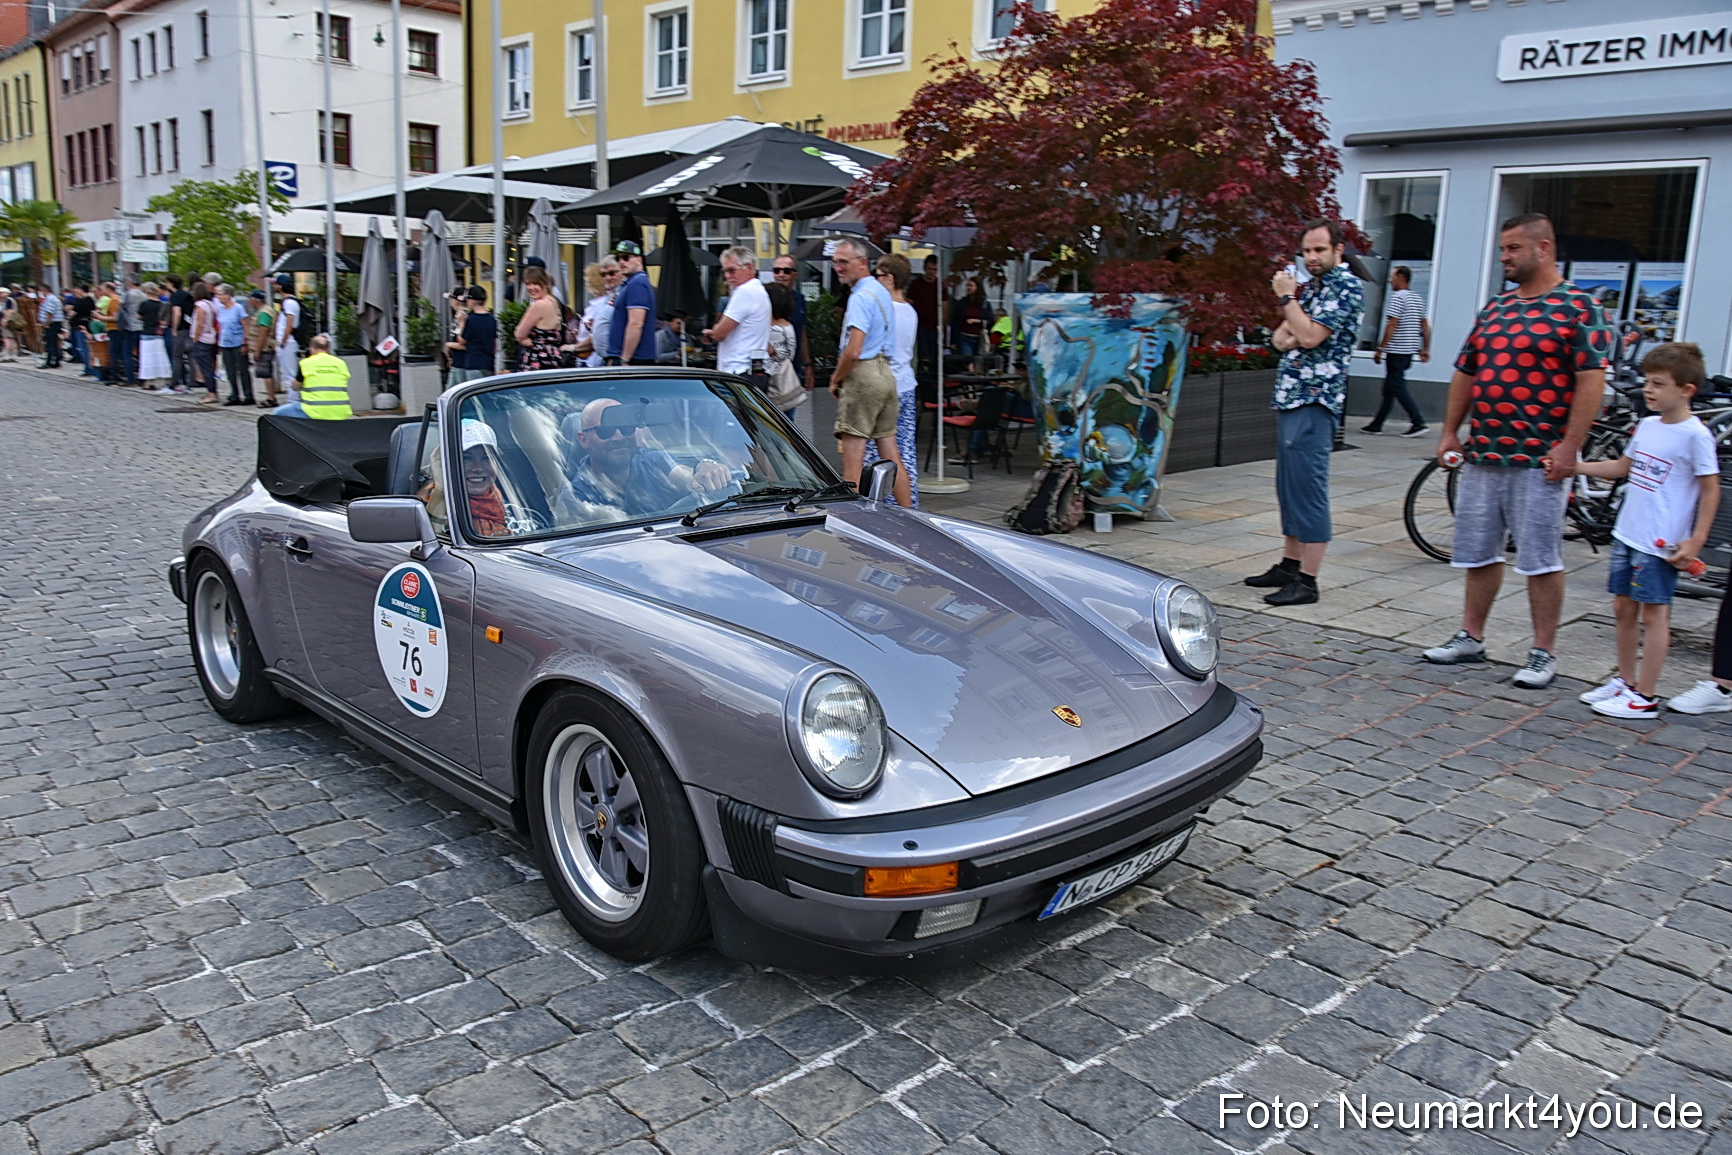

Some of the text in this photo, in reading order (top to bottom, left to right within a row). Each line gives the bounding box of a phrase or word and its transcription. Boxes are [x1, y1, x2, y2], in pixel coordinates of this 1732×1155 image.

[1519, 27, 1732, 71] RÄTZER IMM
[827, 125, 845, 141] AM
[399, 640, 423, 677] 76
[1059, 879, 1089, 908] N
